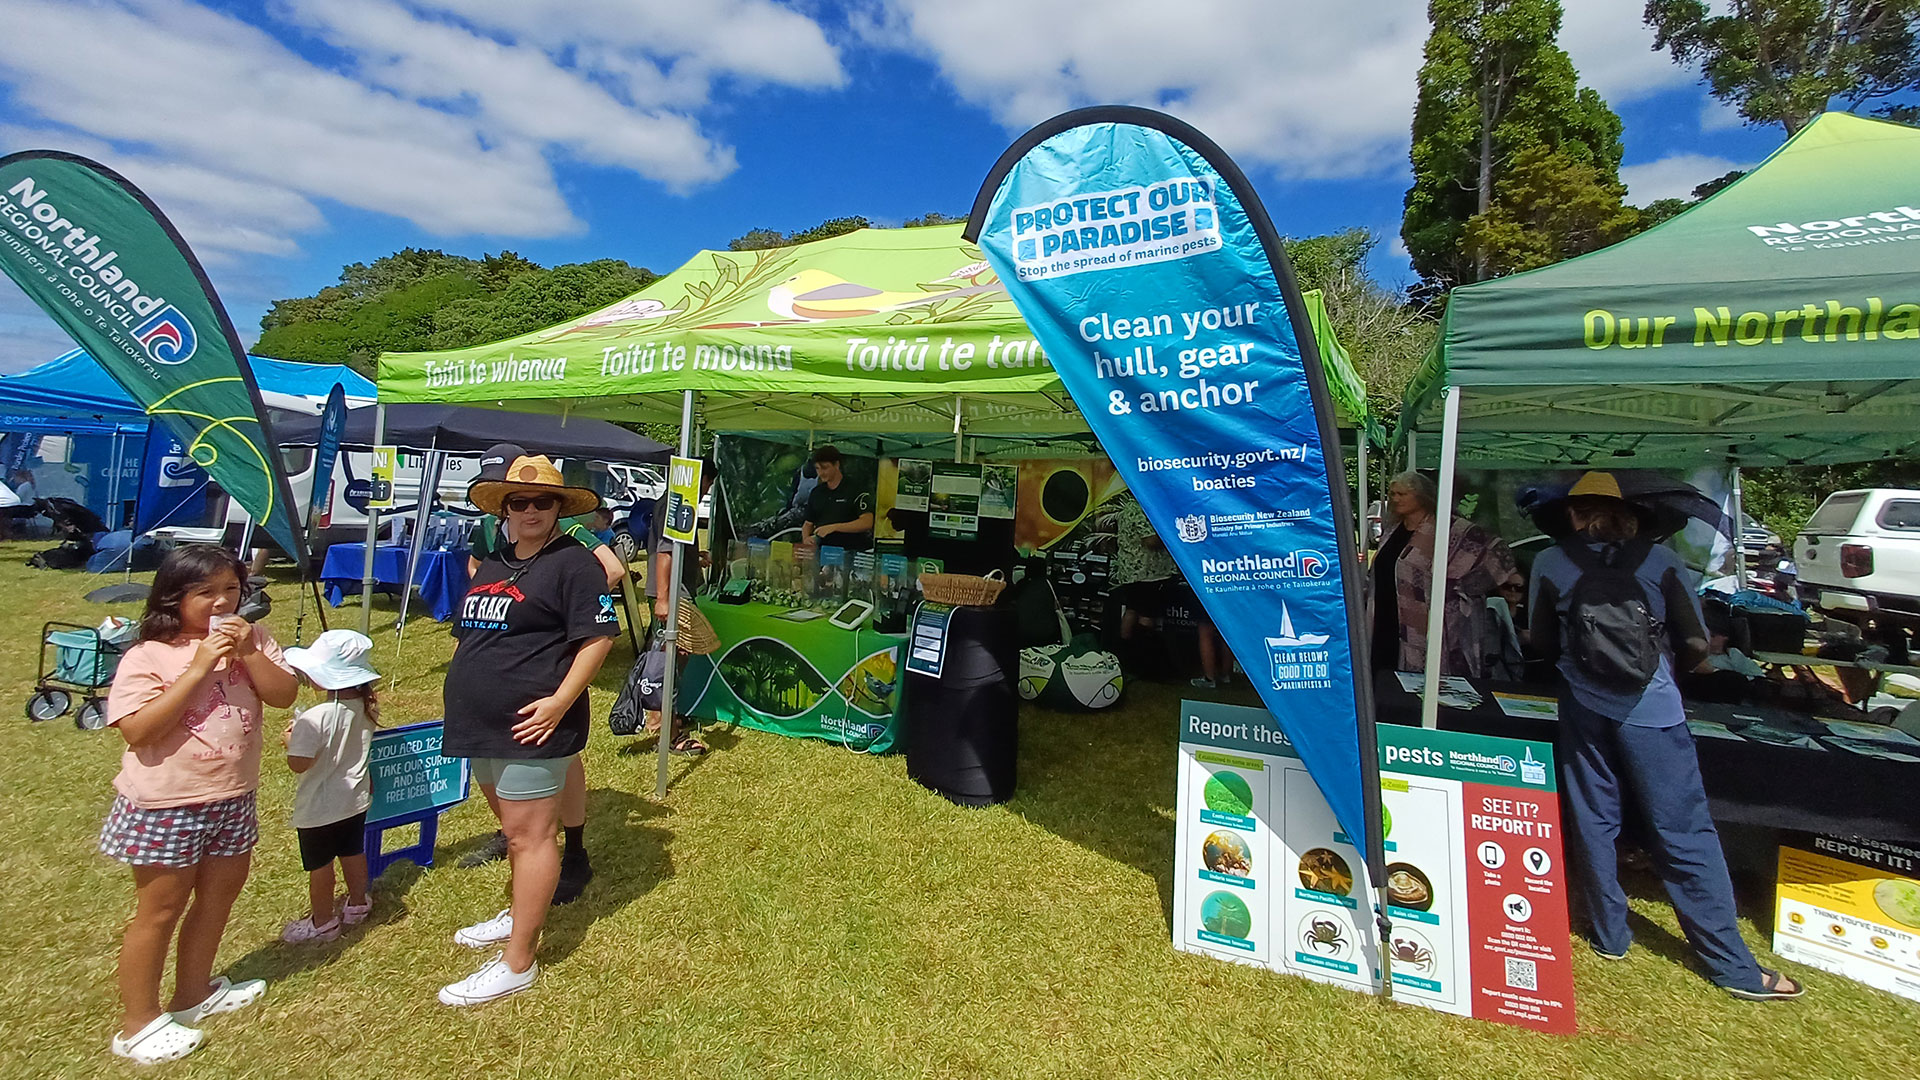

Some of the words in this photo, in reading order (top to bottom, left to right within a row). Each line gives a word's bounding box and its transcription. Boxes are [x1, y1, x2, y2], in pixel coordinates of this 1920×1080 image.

[1015, 191, 1141, 236] PROTECT
[1148, 180, 1211, 211] OUR
[1043, 210, 1188, 257] PARADISE
[8, 177, 165, 317] Northland
[1019, 265, 1048, 278] Stop
[1051, 260, 1070, 272] the
[1073, 253, 1116, 270] spread
[1119, 250, 1132, 262] of
[1135, 244, 1179, 260] marine
[1182, 236, 1217, 254] pests
[69, 266, 135, 328] COUNCIL
[57, 283, 84, 307] rohe
[84, 308, 93, 316] o
[94, 314, 107, 329] Te
[109, 328, 161, 380] Taitokerau
[1079, 312, 1173, 343] Clean
[1181, 302, 1260, 340] your
[1583, 309, 1676, 350] Our
[600, 344, 656, 377] Toitū
[661, 342, 686, 371] te
[692, 343, 793, 372] moana
[846, 336, 930, 372] Toitū
[938, 336, 975, 371] te
[1095, 346, 1168, 379] hull,
[1178, 342, 1255, 379] gear
[424, 359, 465, 388] Toitū
[469, 361, 487, 384] te
[490, 352, 568, 383] whenua
[1108, 389, 1132, 415] &
[1140, 379, 1258, 412] anchor
[1137, 443, 1307, 473] biosecurity.govt.nz/
[672, 464, 693, 488] WIN!
[1192, 474, 1256, 492] boaties
[1210, 512, 1255, 524] Biosecurity
[1256, 510, 1275, 520] New
[1277, 508, 1311, 519] Zealand
[1202, 551, 1295, 574] Northland
[1203, 573, 1251, 584] REGIONAL
[1252, 570, 1296, 581] COUNCIL
[1205, 586, 1214, 594] Te
[1215, 584, 1250, 593] Kaunihera
[463, 596, 478, 619] TE
[477, 596, 515, 622] RAKI
[1274, 652, 1297, 664] CLEAN
[1299, 650, 1329, 663] BELOW?
[1279, 665, 1300, 679] GOOD
[1302, 664, 1313, 678] TO
[1315, 663, 1327, 678] GO
[1189, 715, 1248, 742] Report
[377, 745, 397, 759] YOU
[400, 740, 423, 754] AGED
[1385, 745, 1444, 767] pests
[1449, 751, 1500, 765] Northland
[379, 762, 402, 778] TAKE
[404, 759, 423, 773] OUR
[393, 774, 413, 789] AND
[415, 770, 430, 783] GET
[433, 768, 440, 779] A
[386, 789, 406, 804] FREE
[407, 778, 448, 800] ICEBLOCK
[1481, 796, 1513, 817] SEE
[1516, 801, 1540, 819] IT?
[1471, 813, 1534, 836] REPORT
[1537, 822, 1553, 839] IT
[1815, 837, 1884, 863] REPORT
[1887, 854, 1913, 871] IT!
[1813, 907, 1840, 921] THINK
[1872, 924, 1897, 938] SEEN
[1898, 932, 1913, 942] IT?
